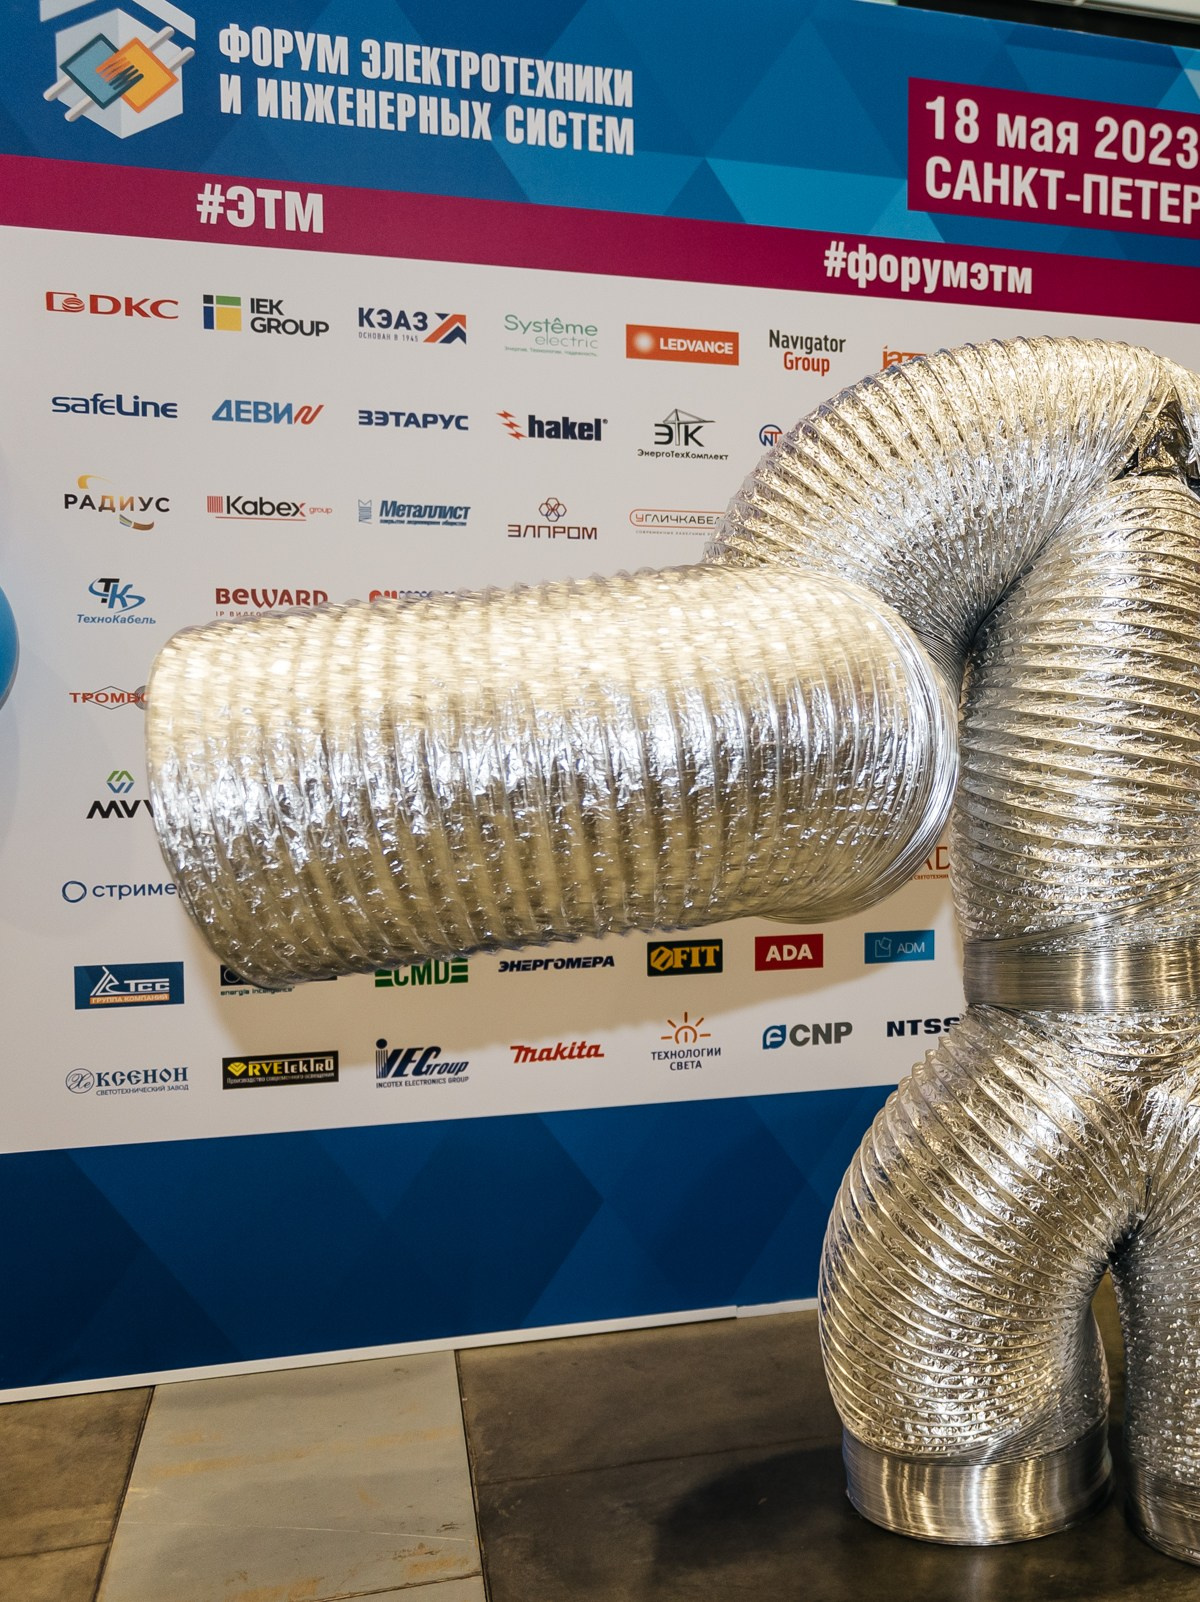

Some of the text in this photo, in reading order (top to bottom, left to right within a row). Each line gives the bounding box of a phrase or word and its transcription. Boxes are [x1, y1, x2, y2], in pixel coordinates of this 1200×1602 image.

[219, 23, 634, 108] ФОРУМ ЭЛЕКТРОТЕХНИКИ
[220, 74, 634, 156] И ИНЖЕНЕРНЫХ СИСТЕМ
[926, 96, 1200, 170] 18 мая 2023
[196, 182, 324, 234] #ЭТМ
[824, 240, 1033, 295] #форумэтм
[89, 294, 179, 319] DKC
[250, 297, 284, 316] IEK
[250, 316, 330, 337] GROUP
[358, 307, 428, 331] КЭАЗ
[535, 335, 598, 349] electric
[659, 337, 734, 355] LEDVANCE
[769, 329, 846, 355] Navigator
[783, 352, 830, 376] Group
[637, 448, 728, 461] ЭнергоТехКомплект
[64, 493, 170, 513] РАДИУС
[226, 495, 306, 518] Kabex
[379, 500, 471, 520] Металлист
[508, 524, 597, 540] ЭЛПРОМ
[77, 614, 156, 625] ТехноКабель
[92, 882, 178, 900] стриме
[673, 945, 720, 968] FIT
[765, 943, 813, 962] ADA
[897, 942, 925, 954] ADM
[498, 956, 615, 972] ЭНЕРГОМЕРА
[789, 1022, 853, 1047] CNP
[651, 1047, 721, 1061] ТЕХНОЛОГИИ
[669, 1060, 702, 1071] СВЕТА
